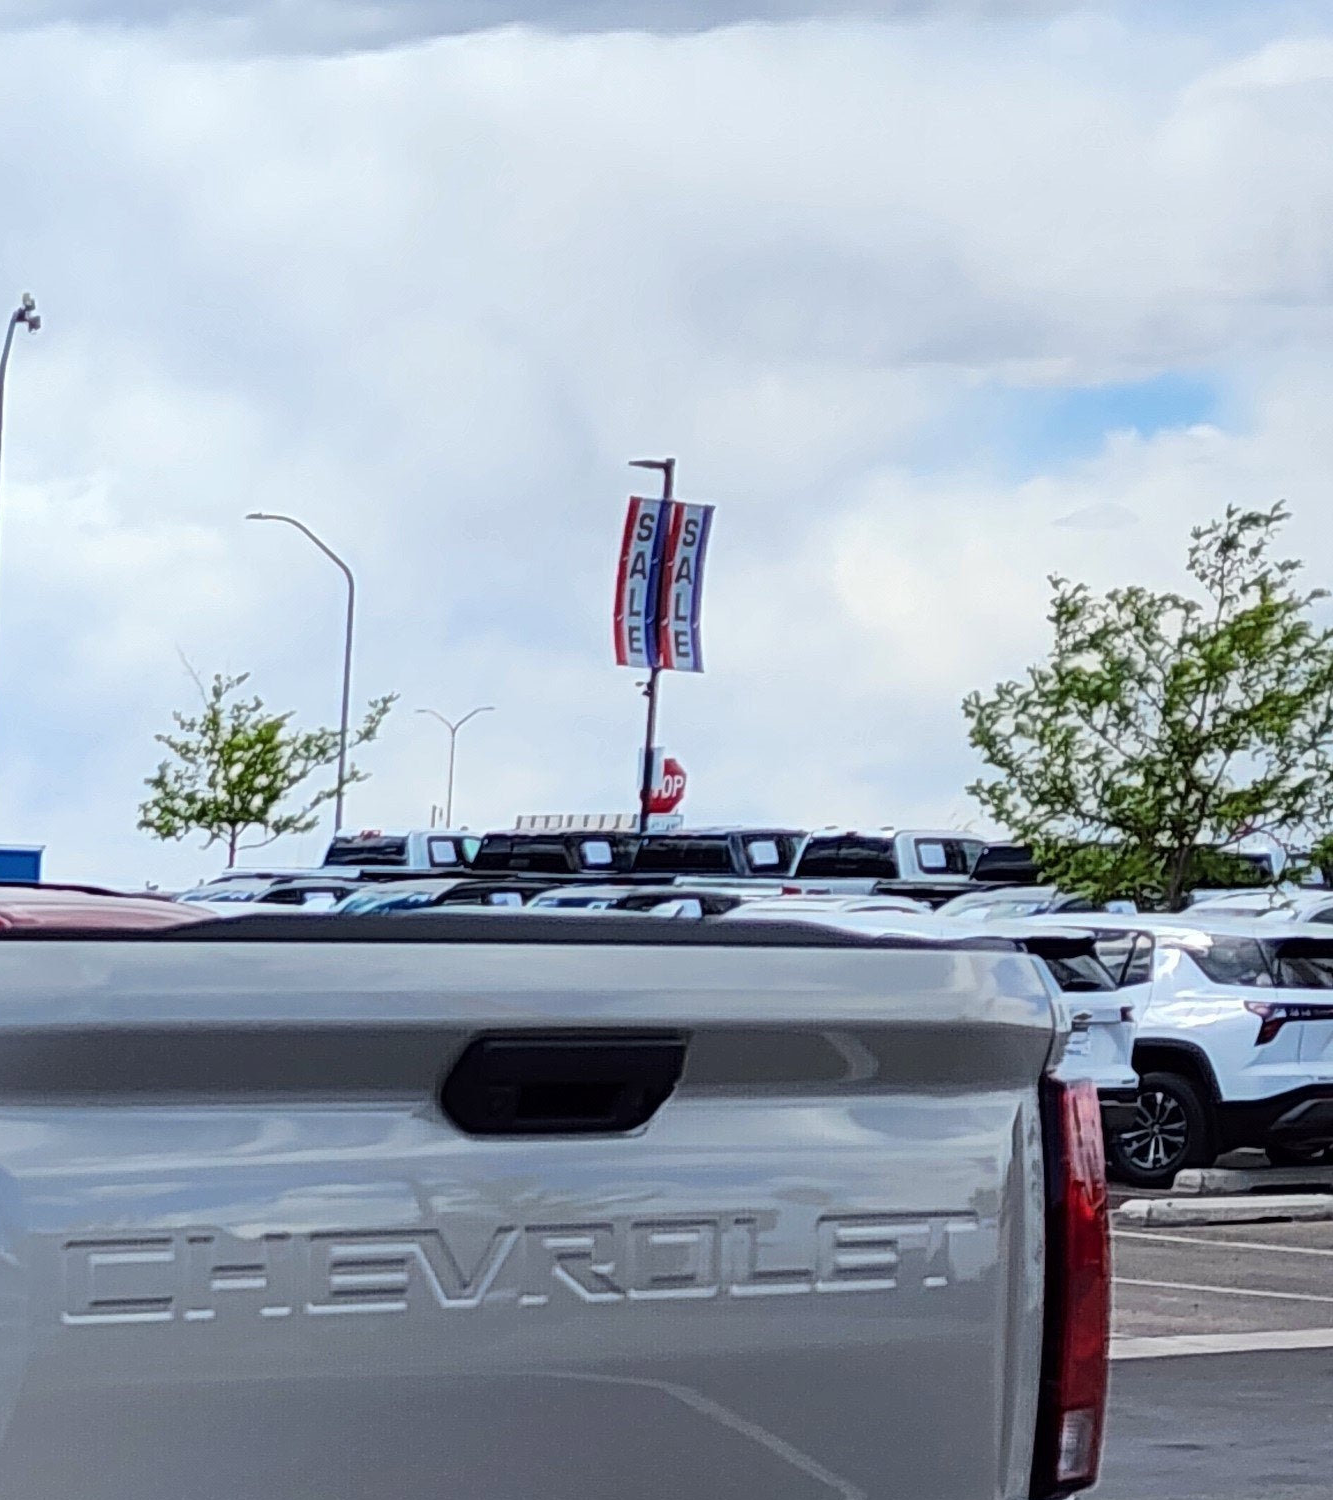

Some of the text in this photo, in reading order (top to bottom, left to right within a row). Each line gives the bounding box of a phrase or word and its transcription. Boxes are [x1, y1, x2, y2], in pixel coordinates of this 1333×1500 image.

[627, 513, 655, 654] SALE
[674, 518, 700, 659] SALE
[652, 774, 684, 799] OP
[61, 1210, 979, 1325] CHEVROLET
